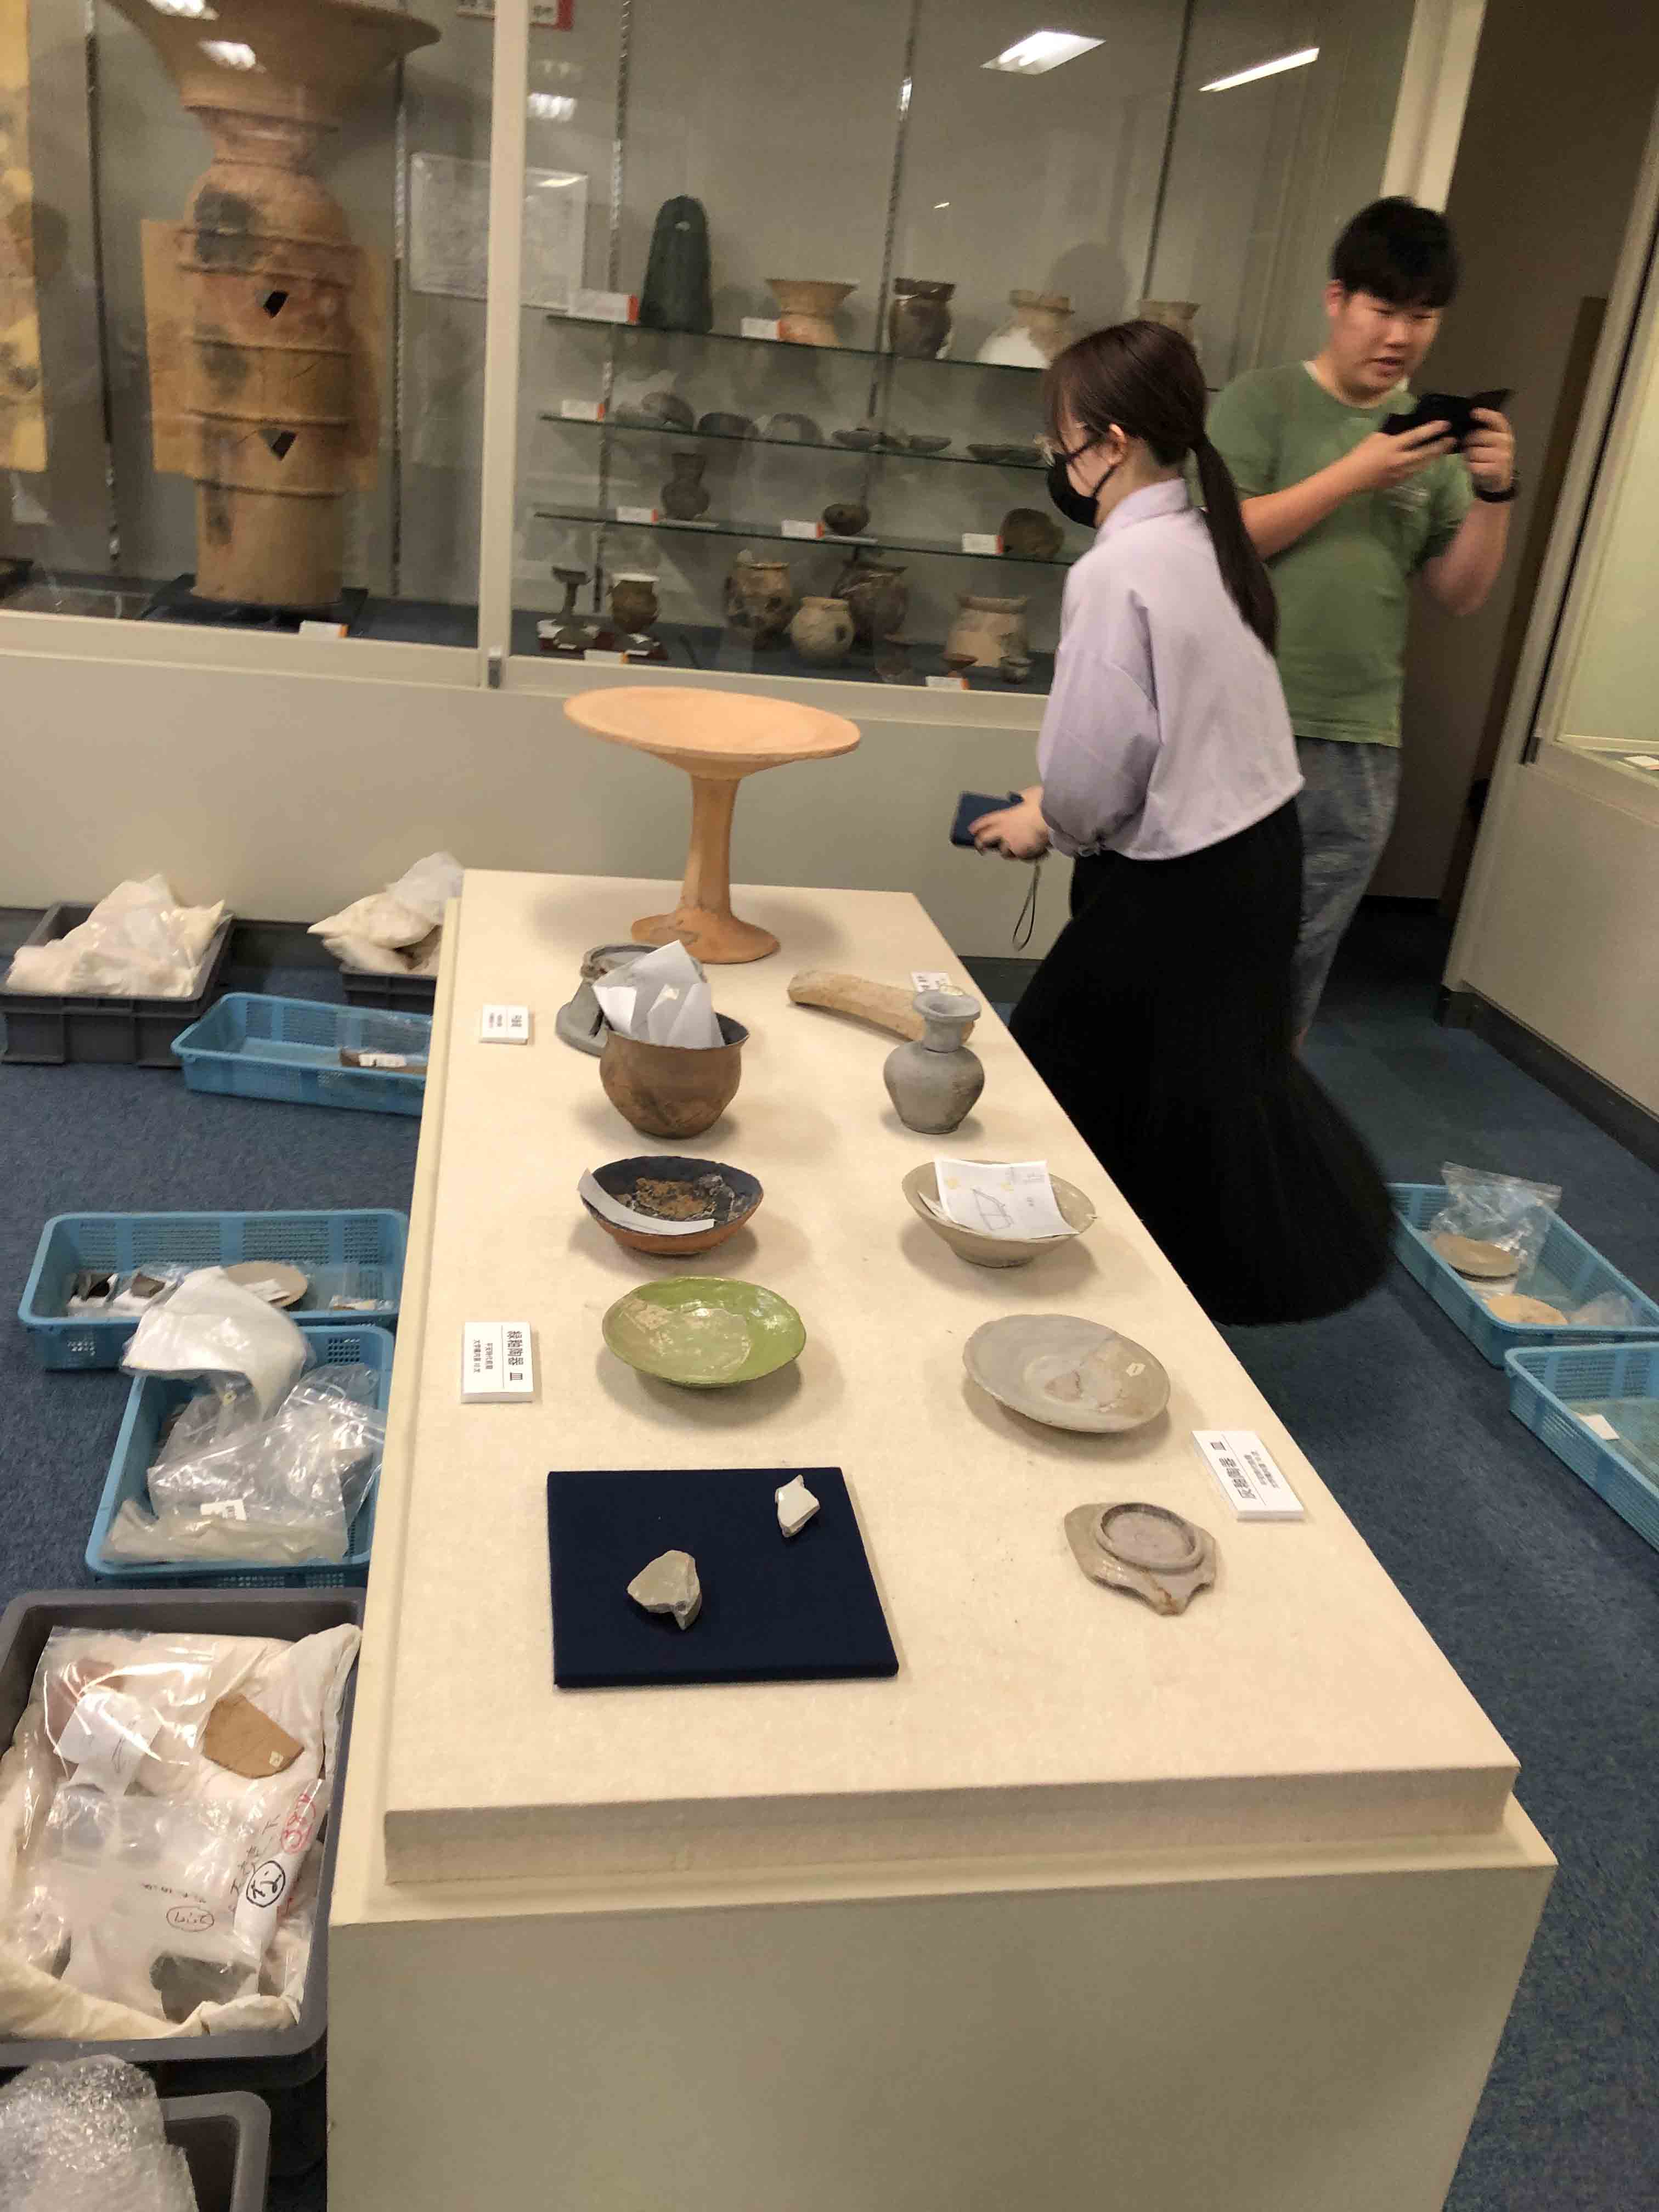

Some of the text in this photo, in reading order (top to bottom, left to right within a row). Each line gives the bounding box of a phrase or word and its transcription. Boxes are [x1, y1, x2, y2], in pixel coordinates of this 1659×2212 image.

[507, 1330, 524, 1381] 緑釉陶器 皿
